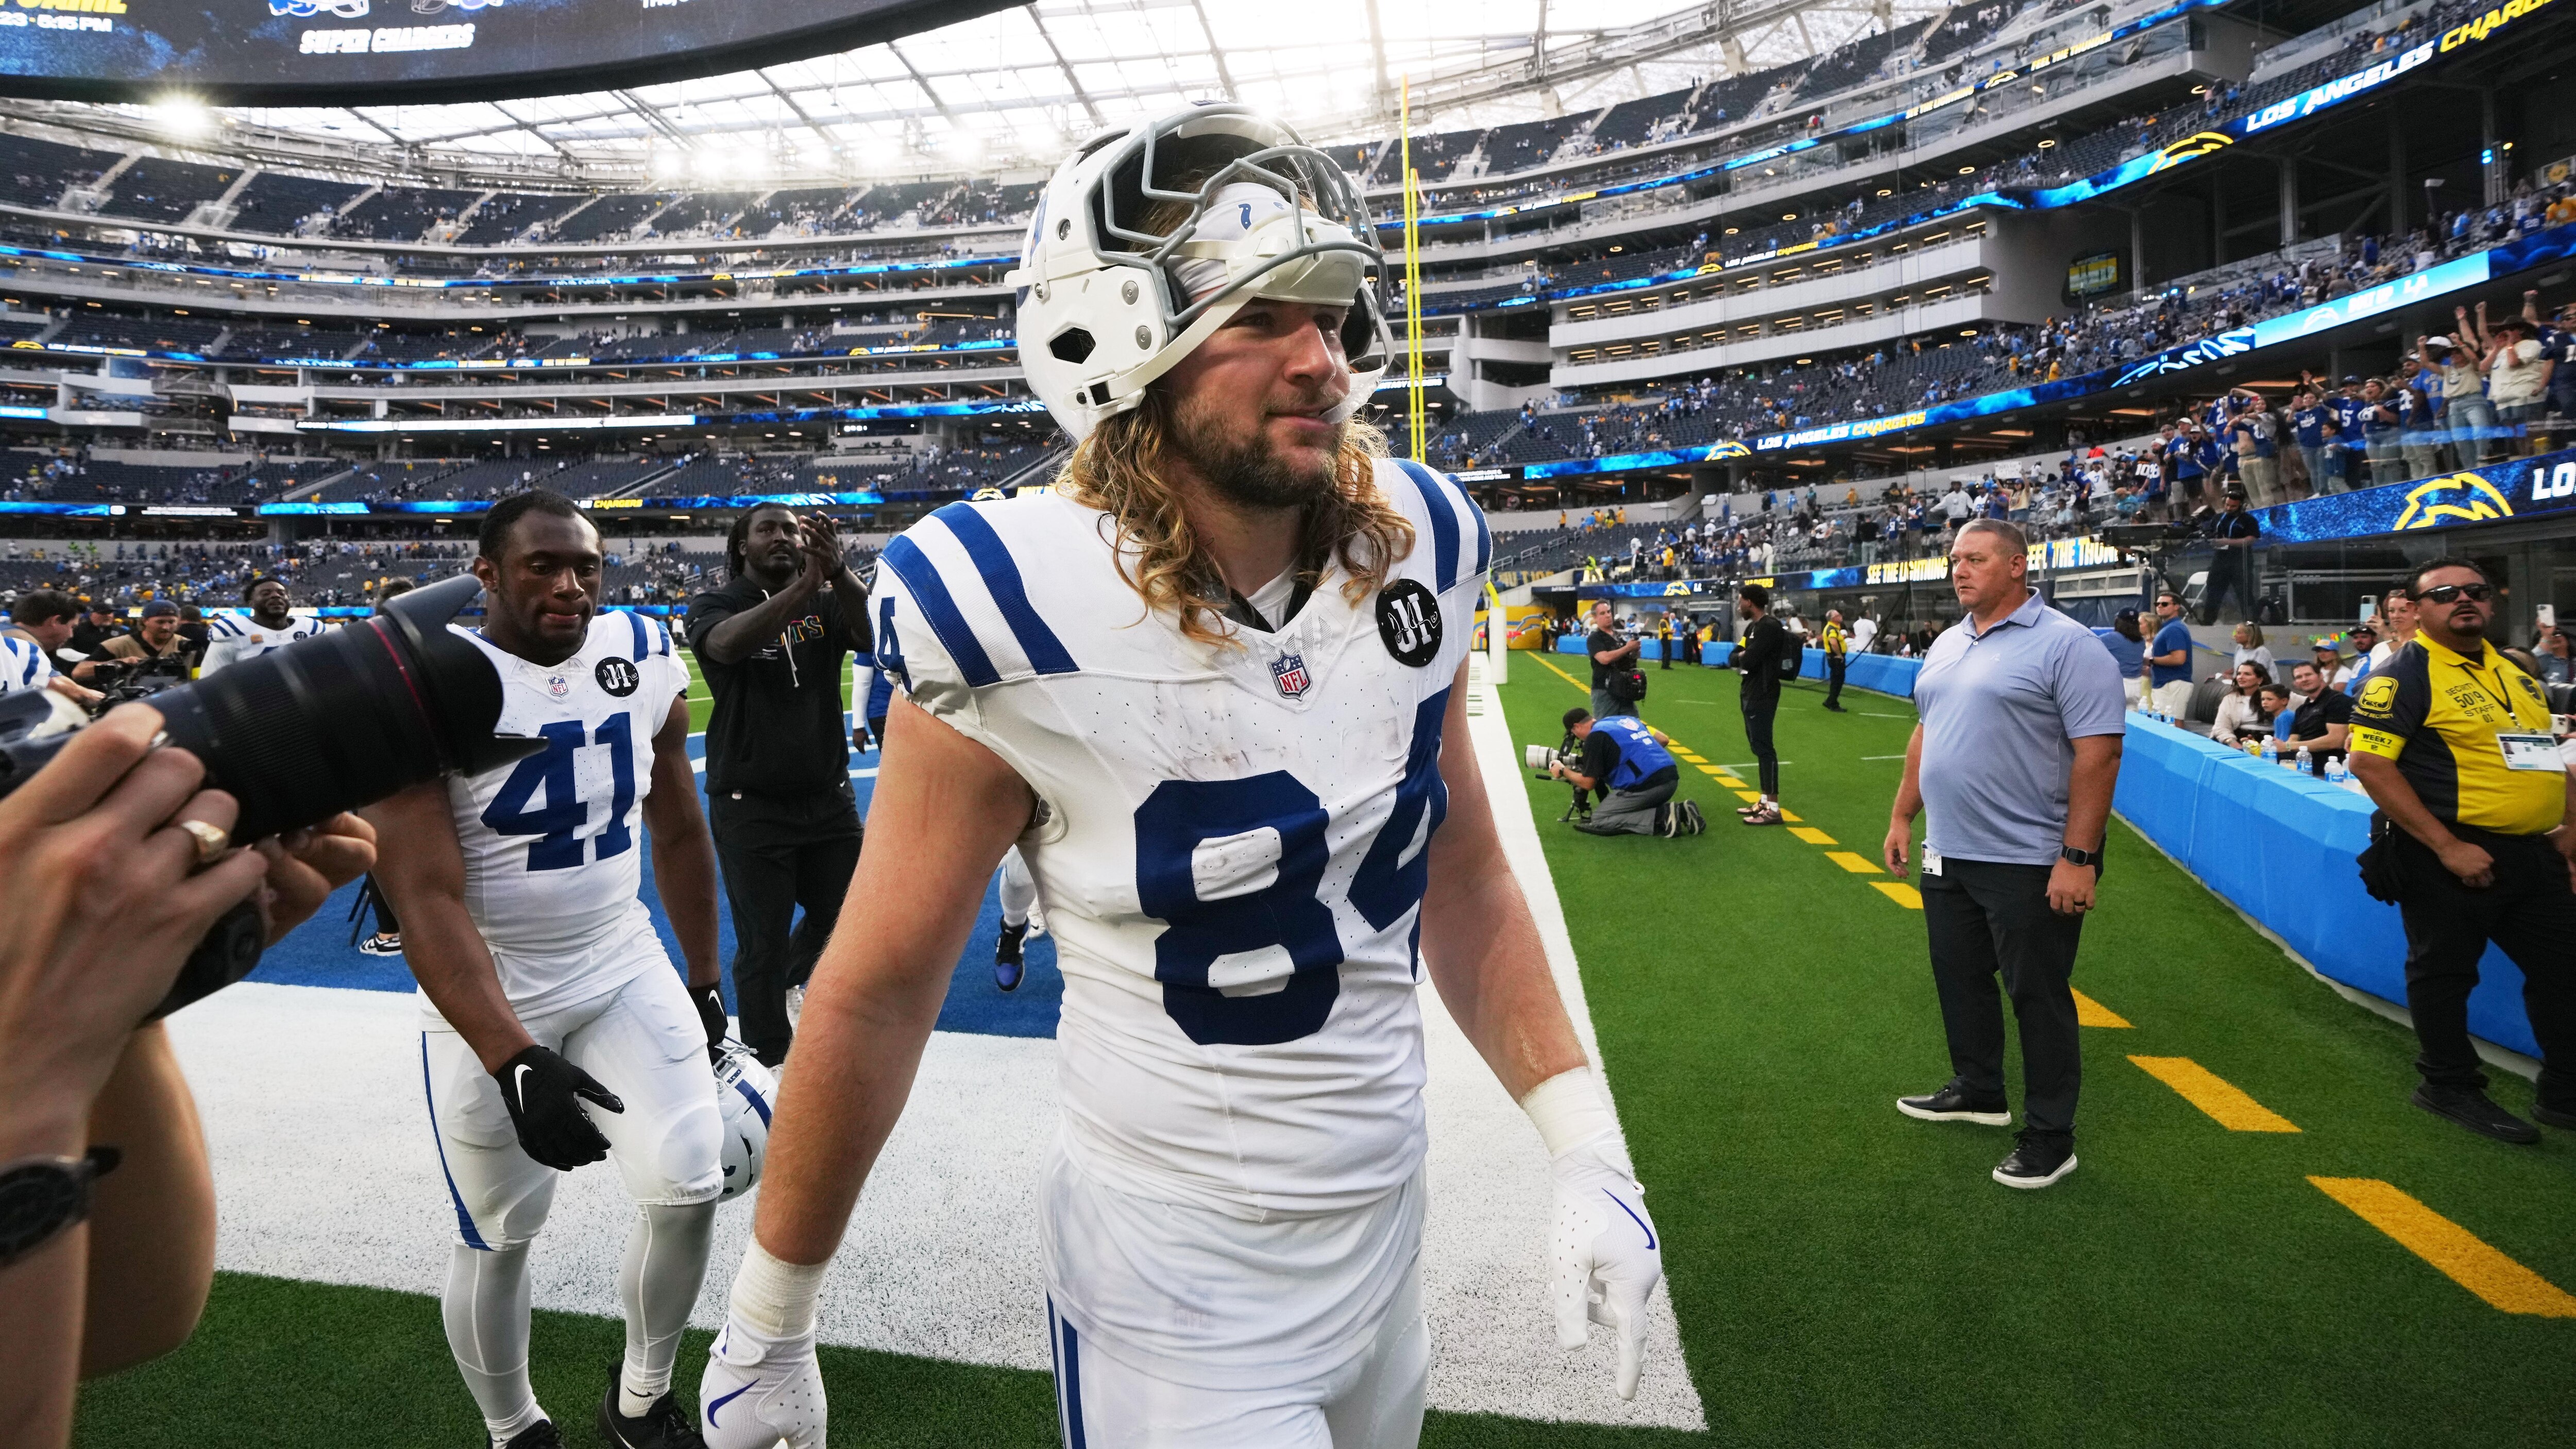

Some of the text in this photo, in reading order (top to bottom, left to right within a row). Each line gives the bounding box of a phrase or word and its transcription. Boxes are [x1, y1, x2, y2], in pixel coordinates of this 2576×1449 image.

[37, 14, 78, 30] 5:15
[79, 16, 113, 32] PM
[299, 23, 476, 54] SUPER CHARGERS
[2245, 97, 2298, 132] LOS
[2301, 40, 2435, 115] ANGELES
[1776, 241, 1819, 256] CHARGERS
[1756, 411, 1927, 450] LOS ANGELES CHARGERS
[2341, 410, 2354, 428] 5
[2531, 462, 2576, 501] LO
[594, 499, 643, 510] CHARGERS
[2052, 539, 2076, 568] THE
[1866, 556, 1948, 584] SEE THE LIGHTNING
[552, 684, 567, 693] NFL
[1279, 669, 1308, 692] NFL
[2364, 700, 2385, 709] CSC
[2464, 704, 2496, 717] STAFF
[2362, 733, 2386, 744] WEEK
[480, 711, 636, 872] 41
[1134, 684, 1452, 1046] 84
